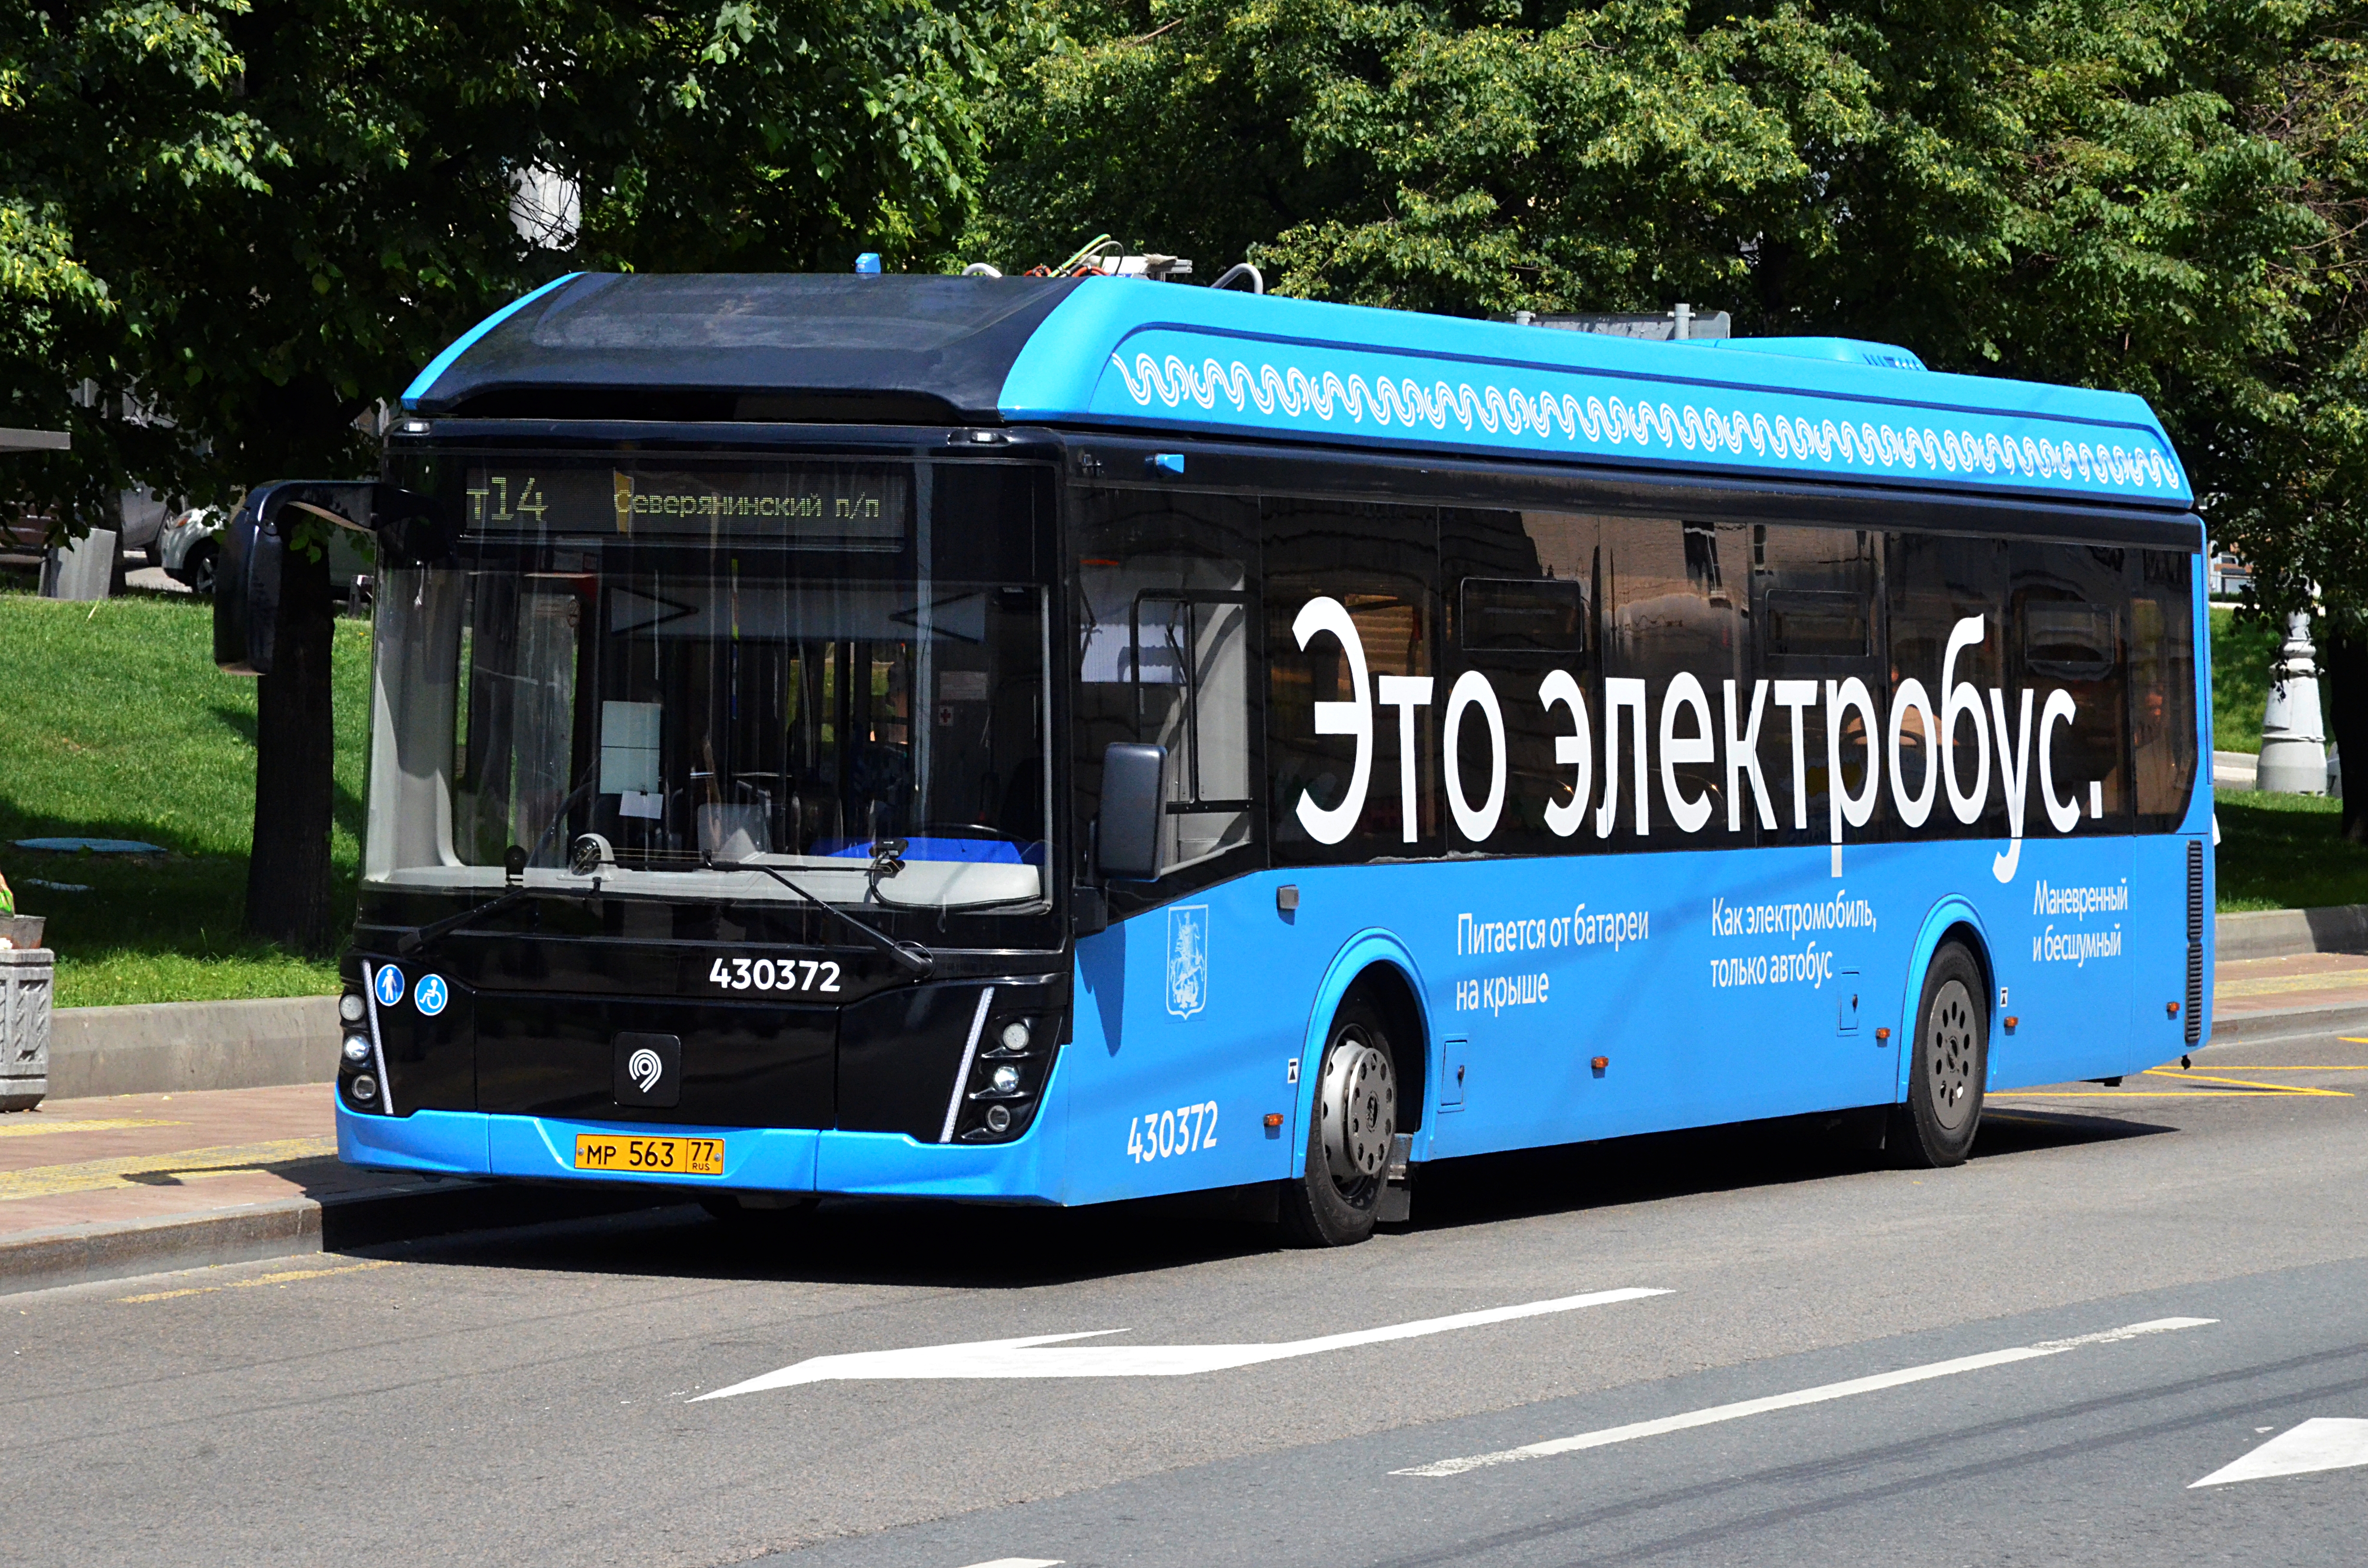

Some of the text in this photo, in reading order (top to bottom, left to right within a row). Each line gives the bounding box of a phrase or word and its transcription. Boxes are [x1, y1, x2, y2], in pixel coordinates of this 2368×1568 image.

[614, 489, 879, 519] Северянинский п/п
[1292, 596, 2103, 884] Это электробус.
[1712, 889, 1876, 940] Как электромобиль,
[2033, 877, 2128, 922] Маневренный
[1458, 903, 1649, 956] Питается от батареи
[2033, 923, 2121, 968] и бесшумный
[709, 958, 841, 992] 430372
[1710, 941, 1833, 989] только автобус
[1456, 972, 1550, 1017] на крыше
[629, 1141, 675, 1167] 563
[691, 1141, 715, 1162] 77
[1127, 1100, 1218, 1164] 430372
[692, 1163, 711, 1171] RUS
